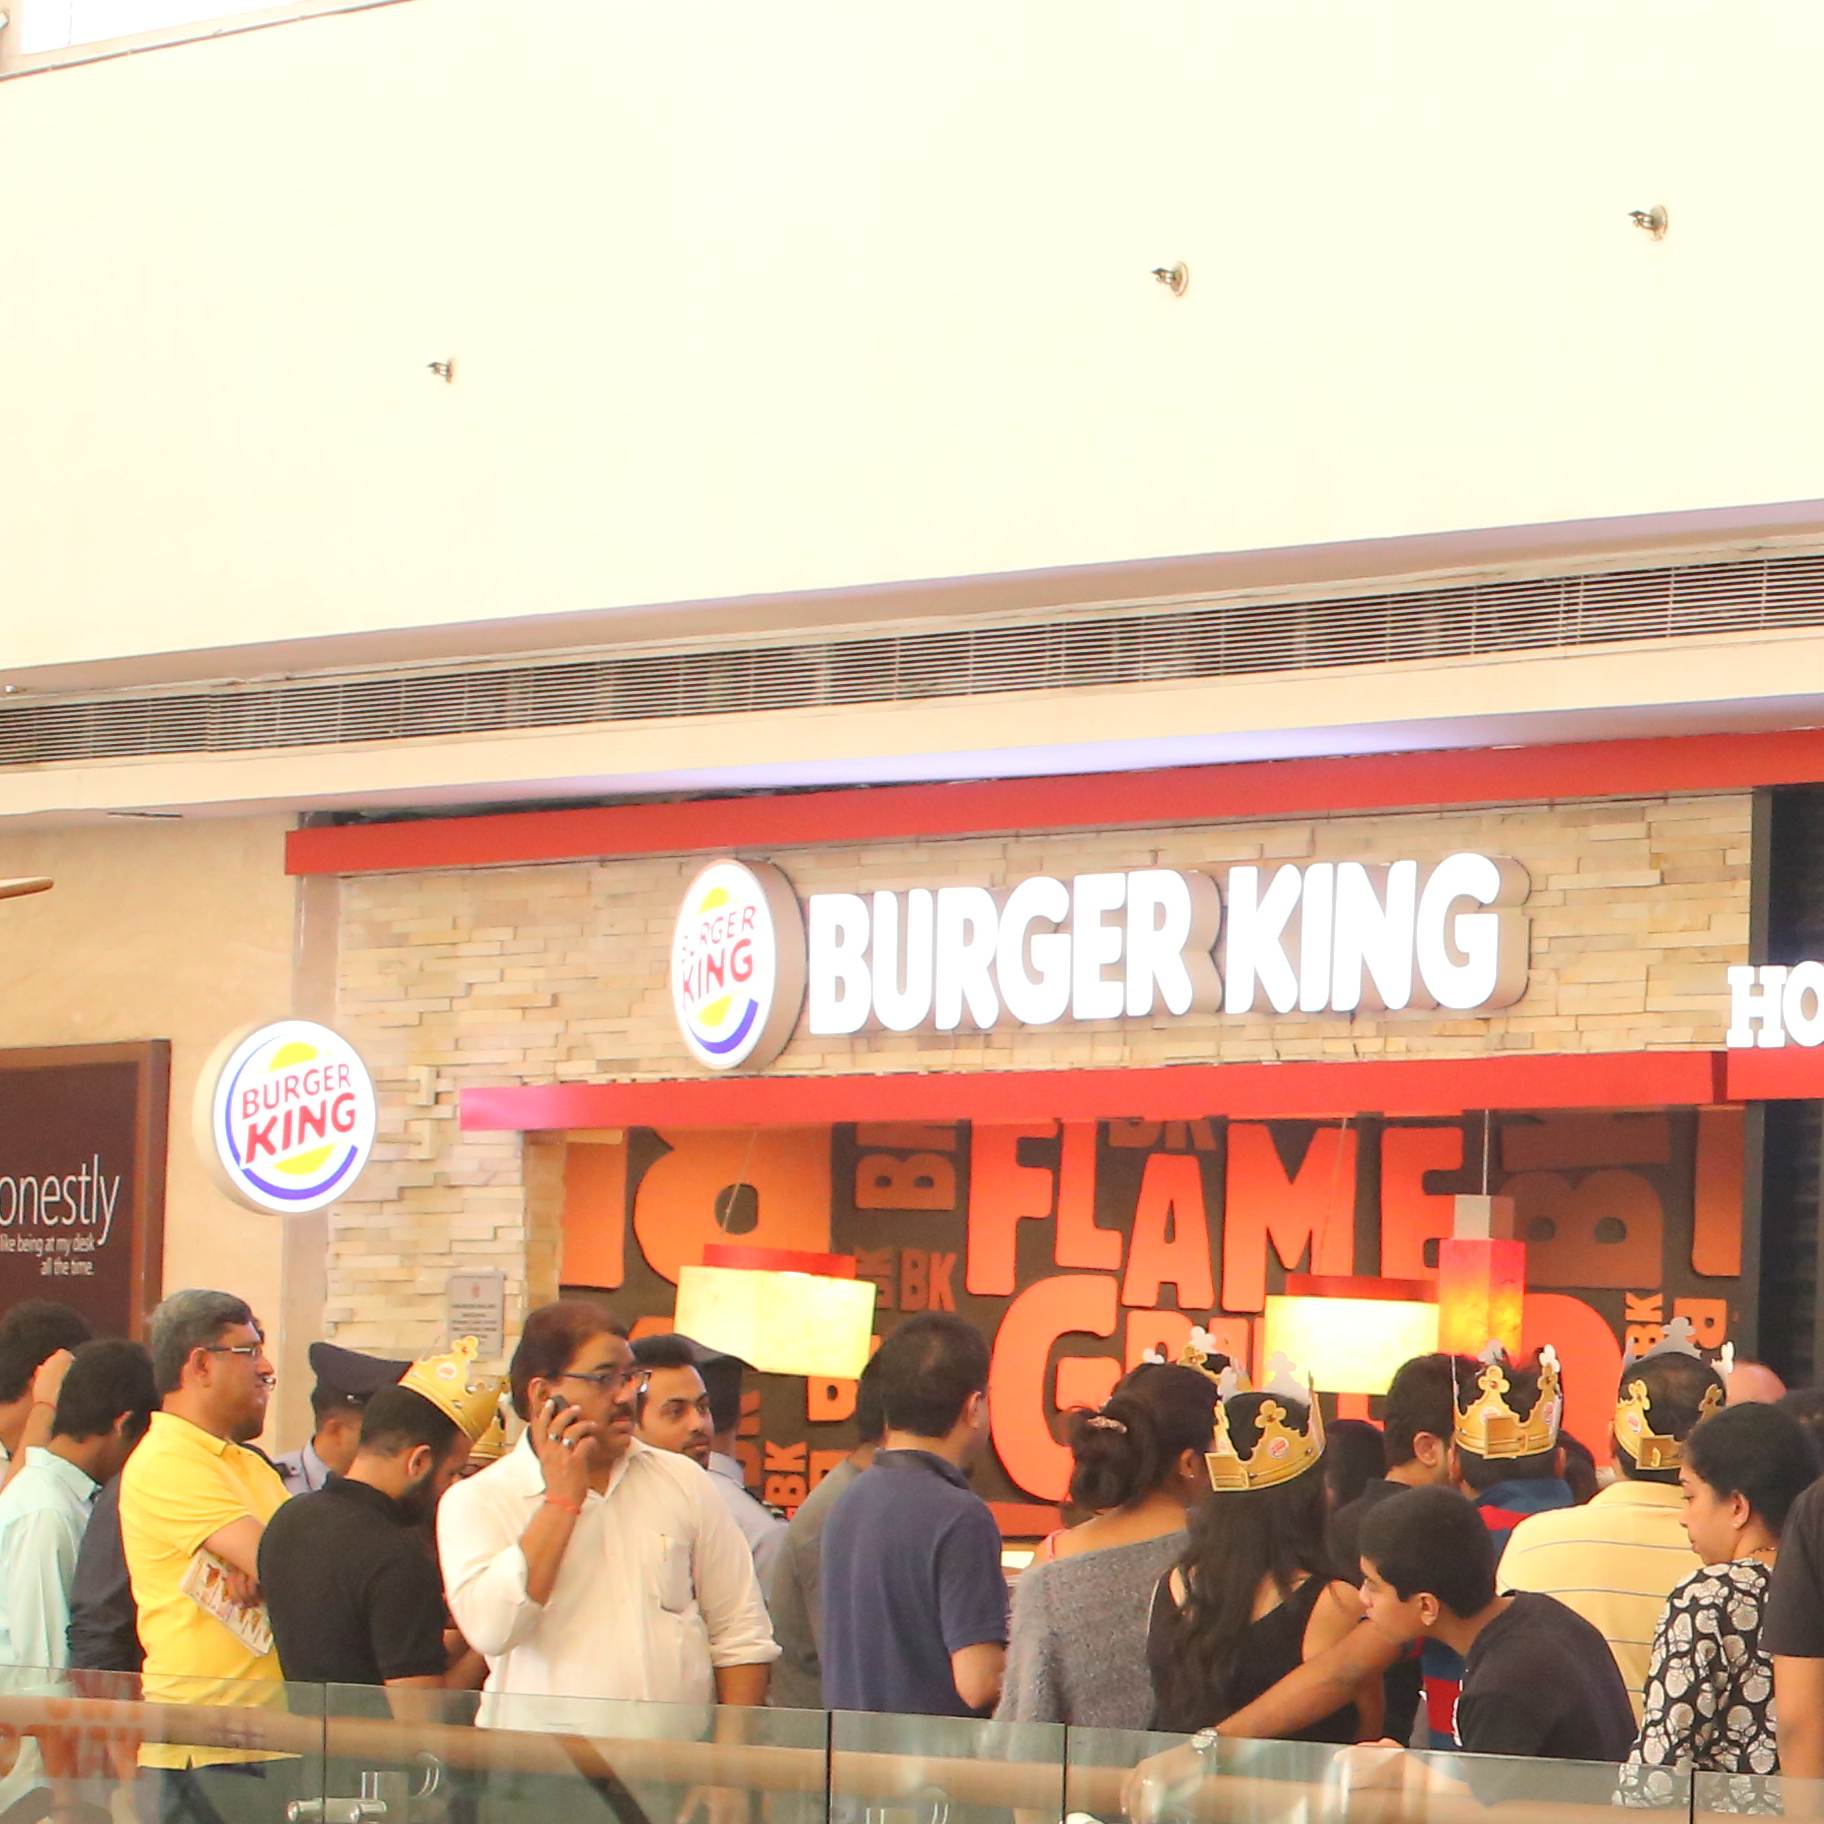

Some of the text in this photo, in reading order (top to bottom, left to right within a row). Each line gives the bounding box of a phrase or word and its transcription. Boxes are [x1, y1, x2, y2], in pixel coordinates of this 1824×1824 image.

[683, 938, 754, 1012] KING
[808, 852, 1503, 1035] BURGER KING
[242, 1064, 352, 1121] BURGER
[245, 1092, 356, 1165] KING
[0, 1153, 120, 1246] onestly
[966, 1118, 1465, 1313] FLAME
[901, 1251, 957, 1313] BK
[765, 1441, 808, 1506] BK
